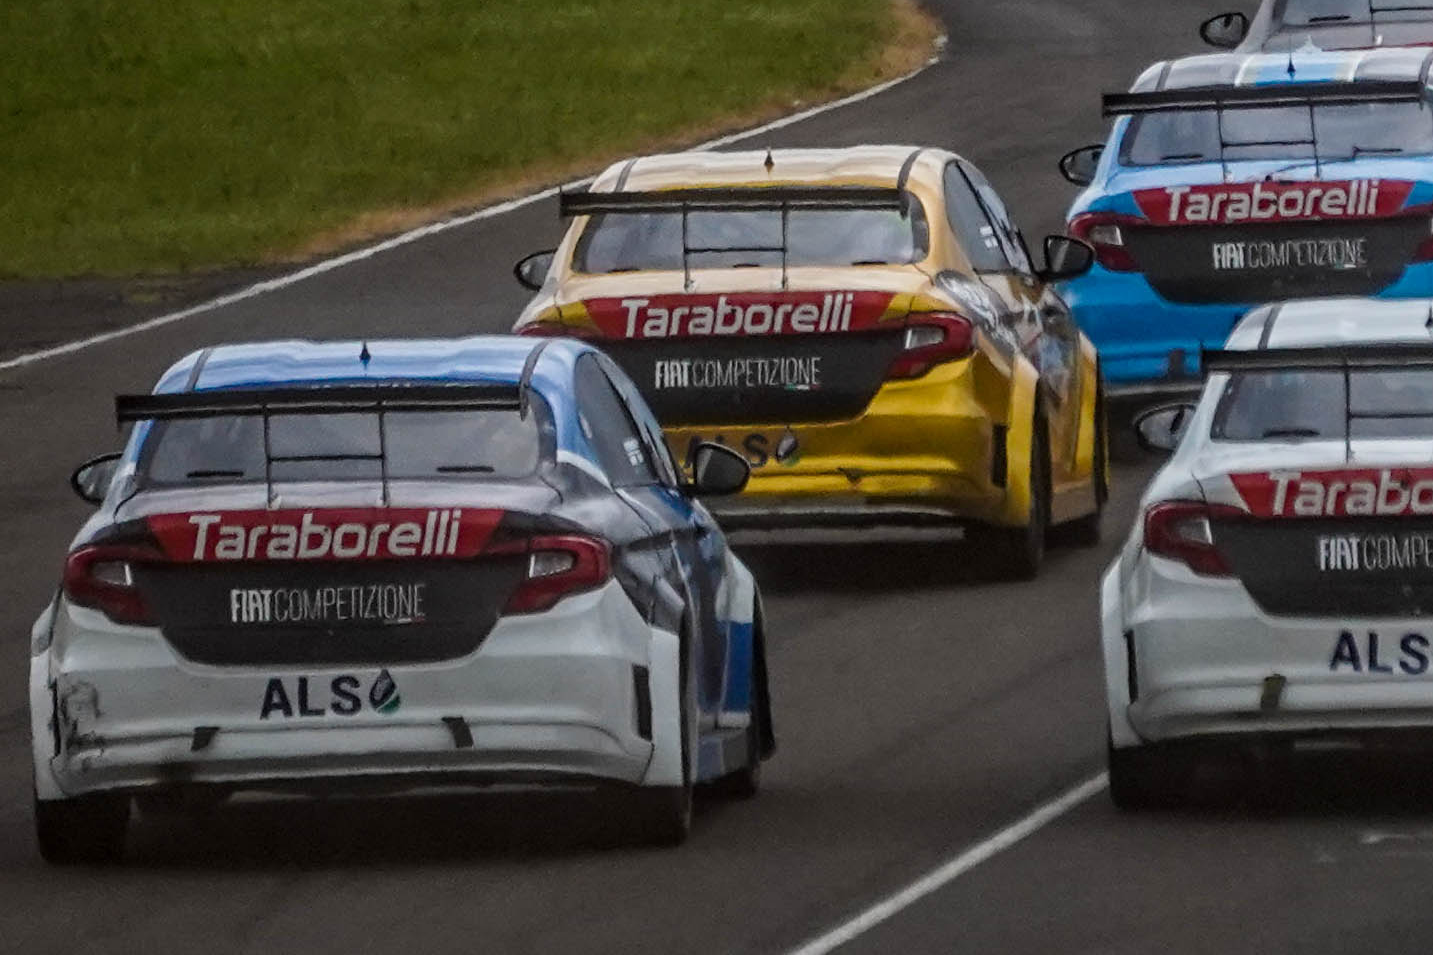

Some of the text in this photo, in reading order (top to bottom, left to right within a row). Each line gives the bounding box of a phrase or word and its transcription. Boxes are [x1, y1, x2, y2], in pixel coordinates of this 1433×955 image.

[1165, 179, 1379, 222] Taraborelli
[621, 293, 853, 338] Taraborelli
[189, 509, 462, 560] Taraborelli
